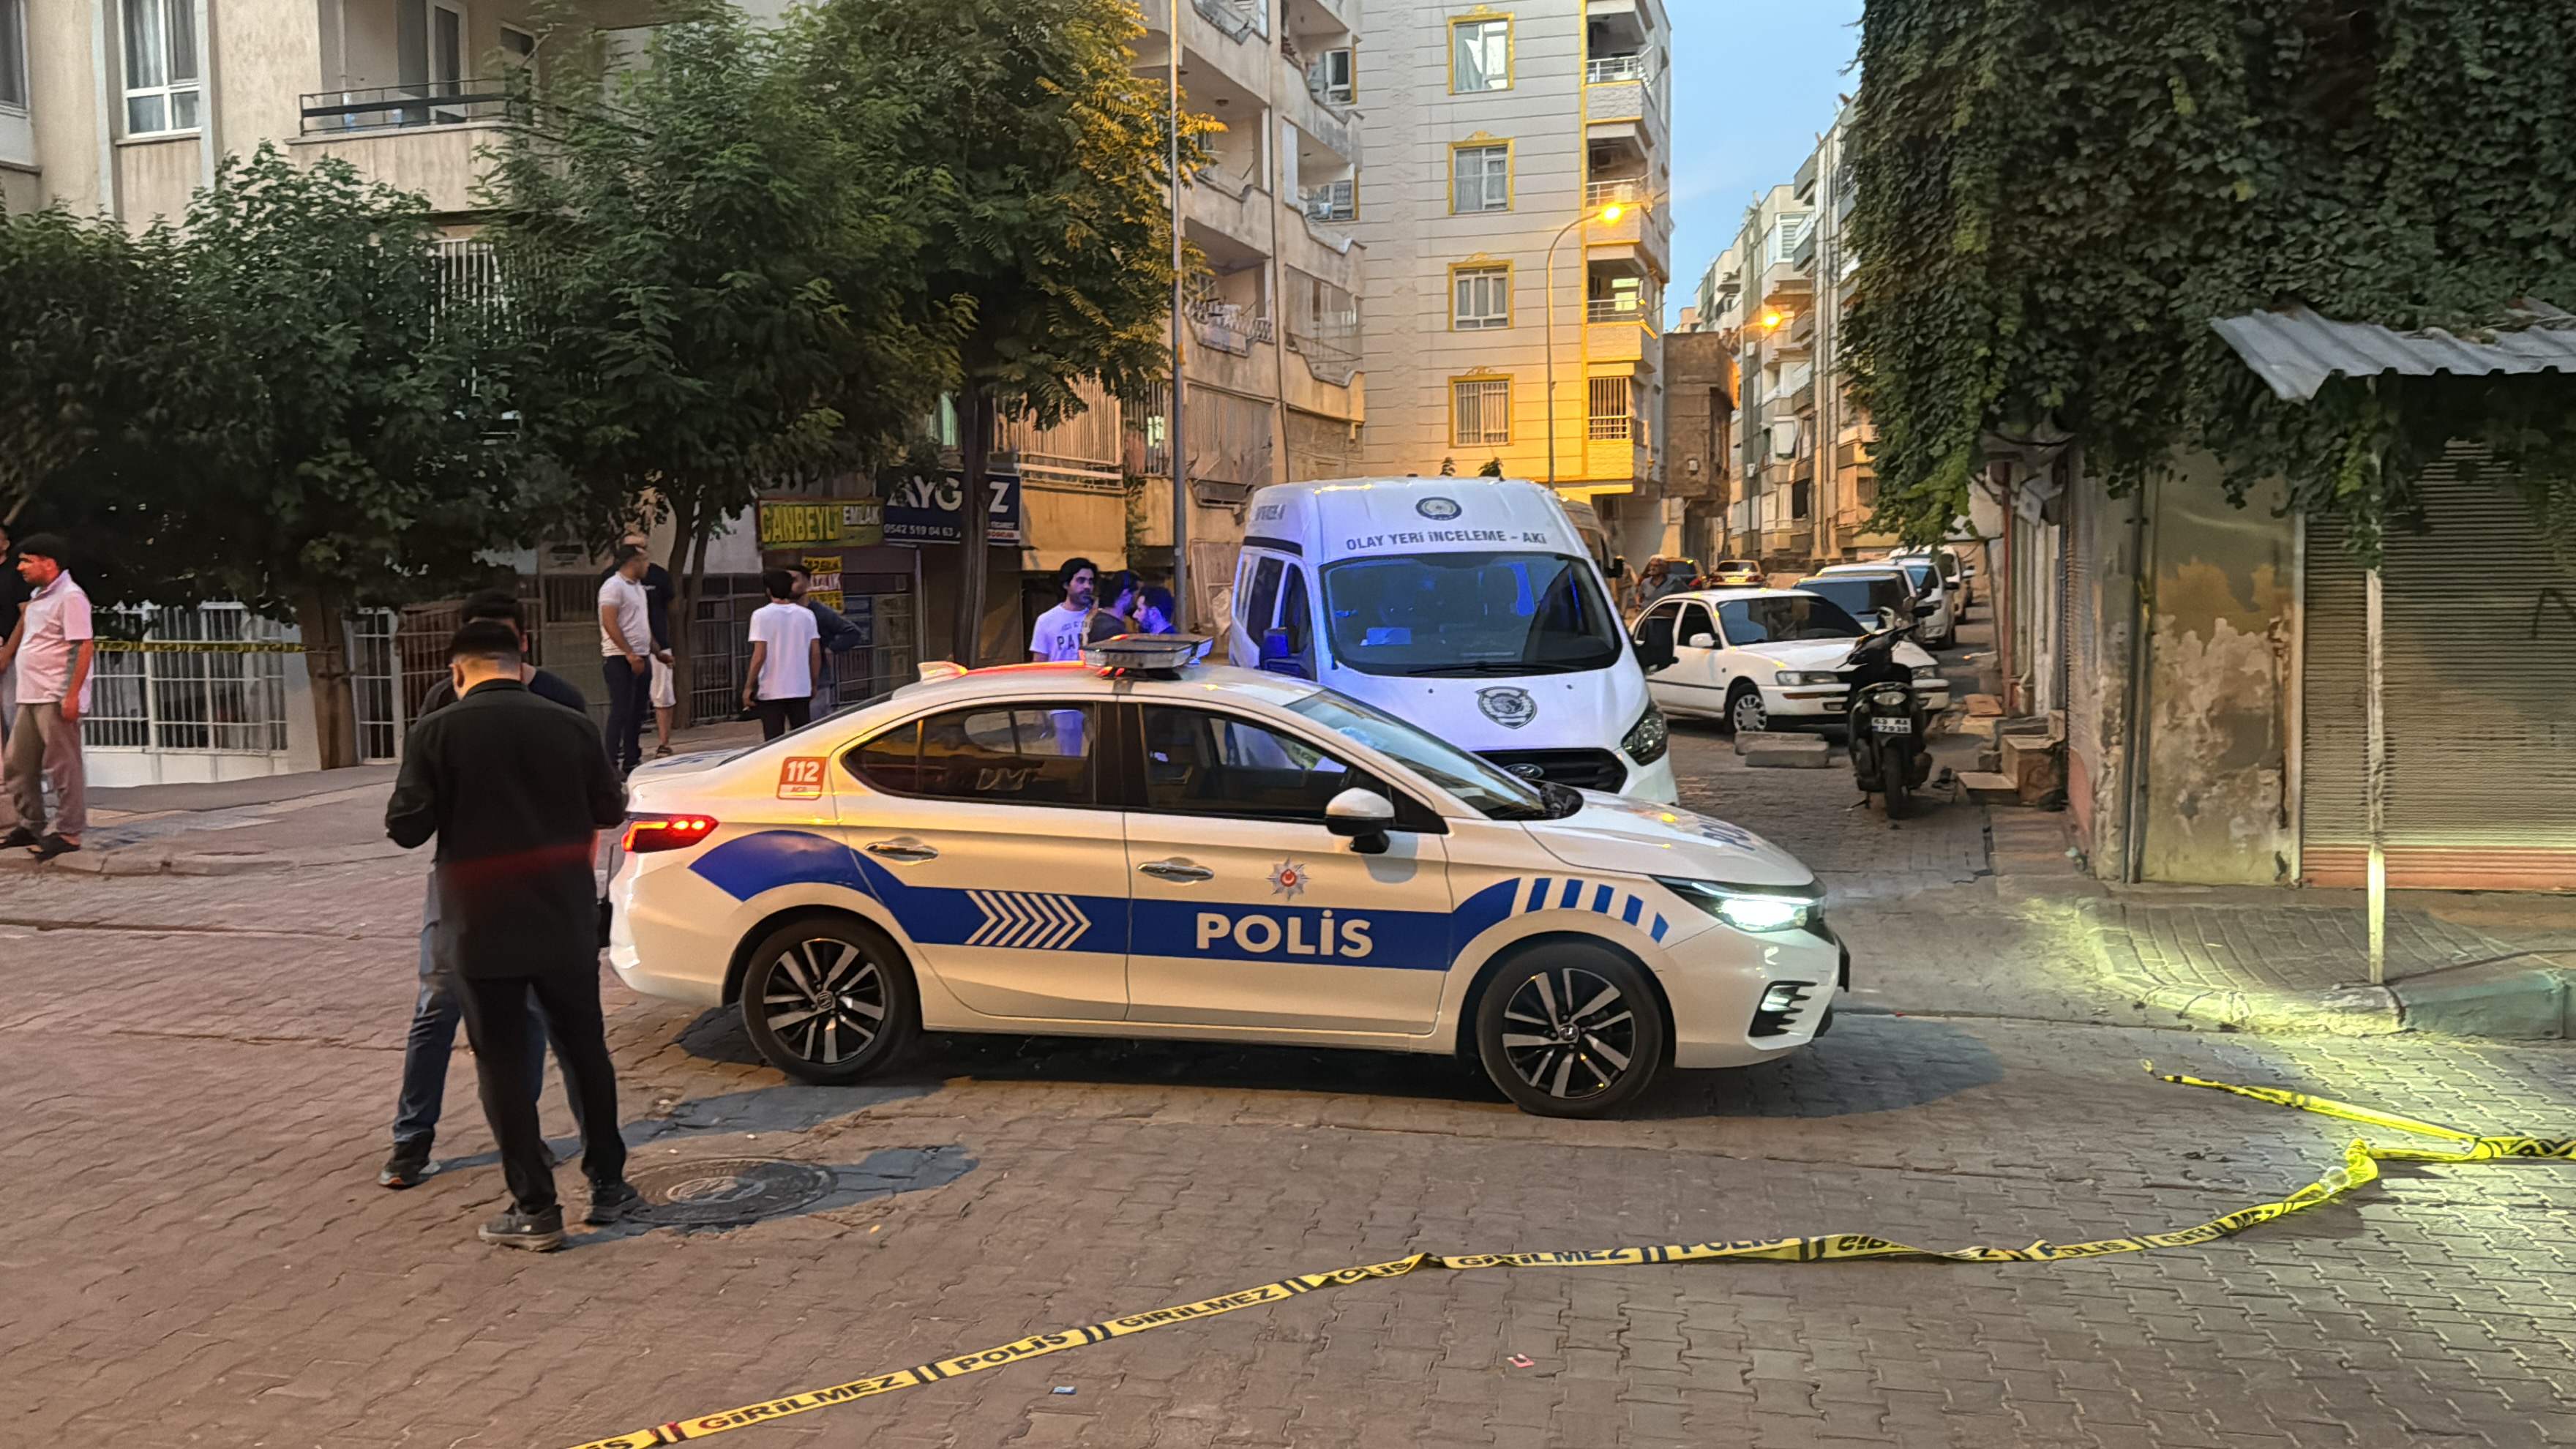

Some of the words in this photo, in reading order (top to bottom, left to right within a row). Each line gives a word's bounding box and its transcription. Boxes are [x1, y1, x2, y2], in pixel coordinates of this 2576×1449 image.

[887, 476, 1010, 513] AYGZ
[884, 524, 907, 534] 0542
[1346, 535, 1383, 550] OLAY
[1388, 532, 1424, 545] YERİ
[1429, 530, 1506, 542] İNCELEME
[787, 760, 820, 782] 112
[1196, 909, 1374, 958] POLİS
[1115, 1287, 1280, 1328] GİRİLMEZ
[952, 1333, 1068, 1371] POLİS
[697, 1375, 905, 1429] GİRİLMEZ
